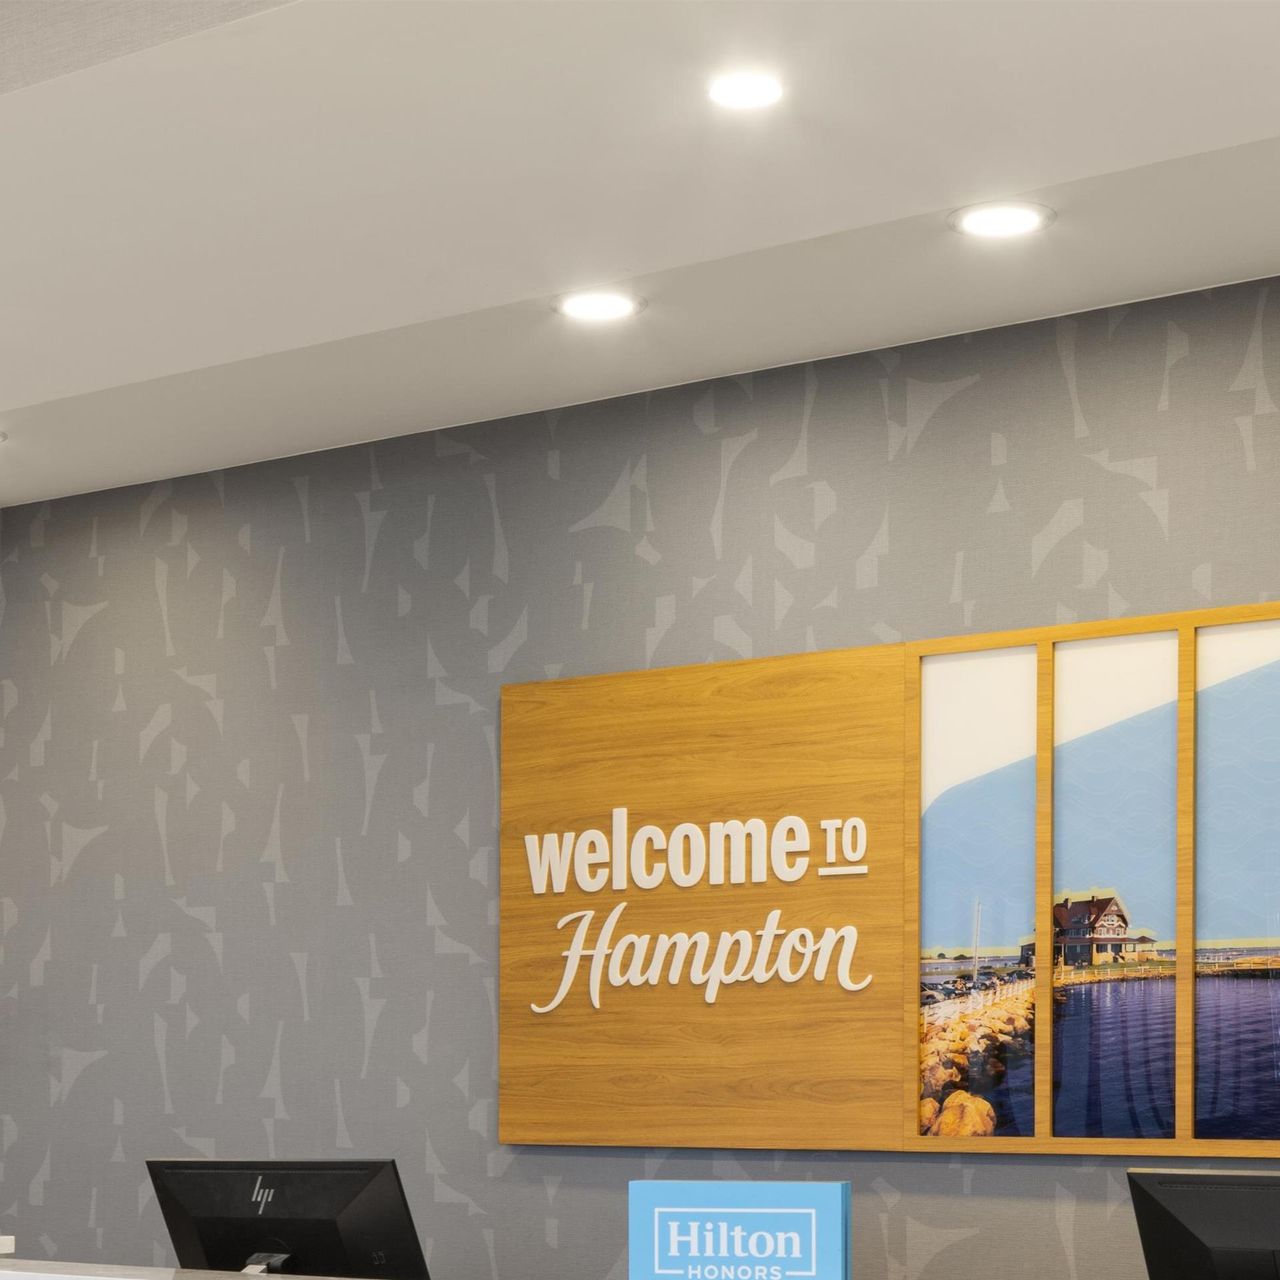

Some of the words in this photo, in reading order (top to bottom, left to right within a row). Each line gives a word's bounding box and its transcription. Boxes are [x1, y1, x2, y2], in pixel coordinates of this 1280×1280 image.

[524, 808, 810, 894] welcome
[820, 817, 867, 864] TO
[530, 902, 873, 1013] Hampton
[251, 1176, 275, 1215] hp
[668, 1221, 803, 1258] Hilton
[687, 1264, 783, 1280] HONORS
